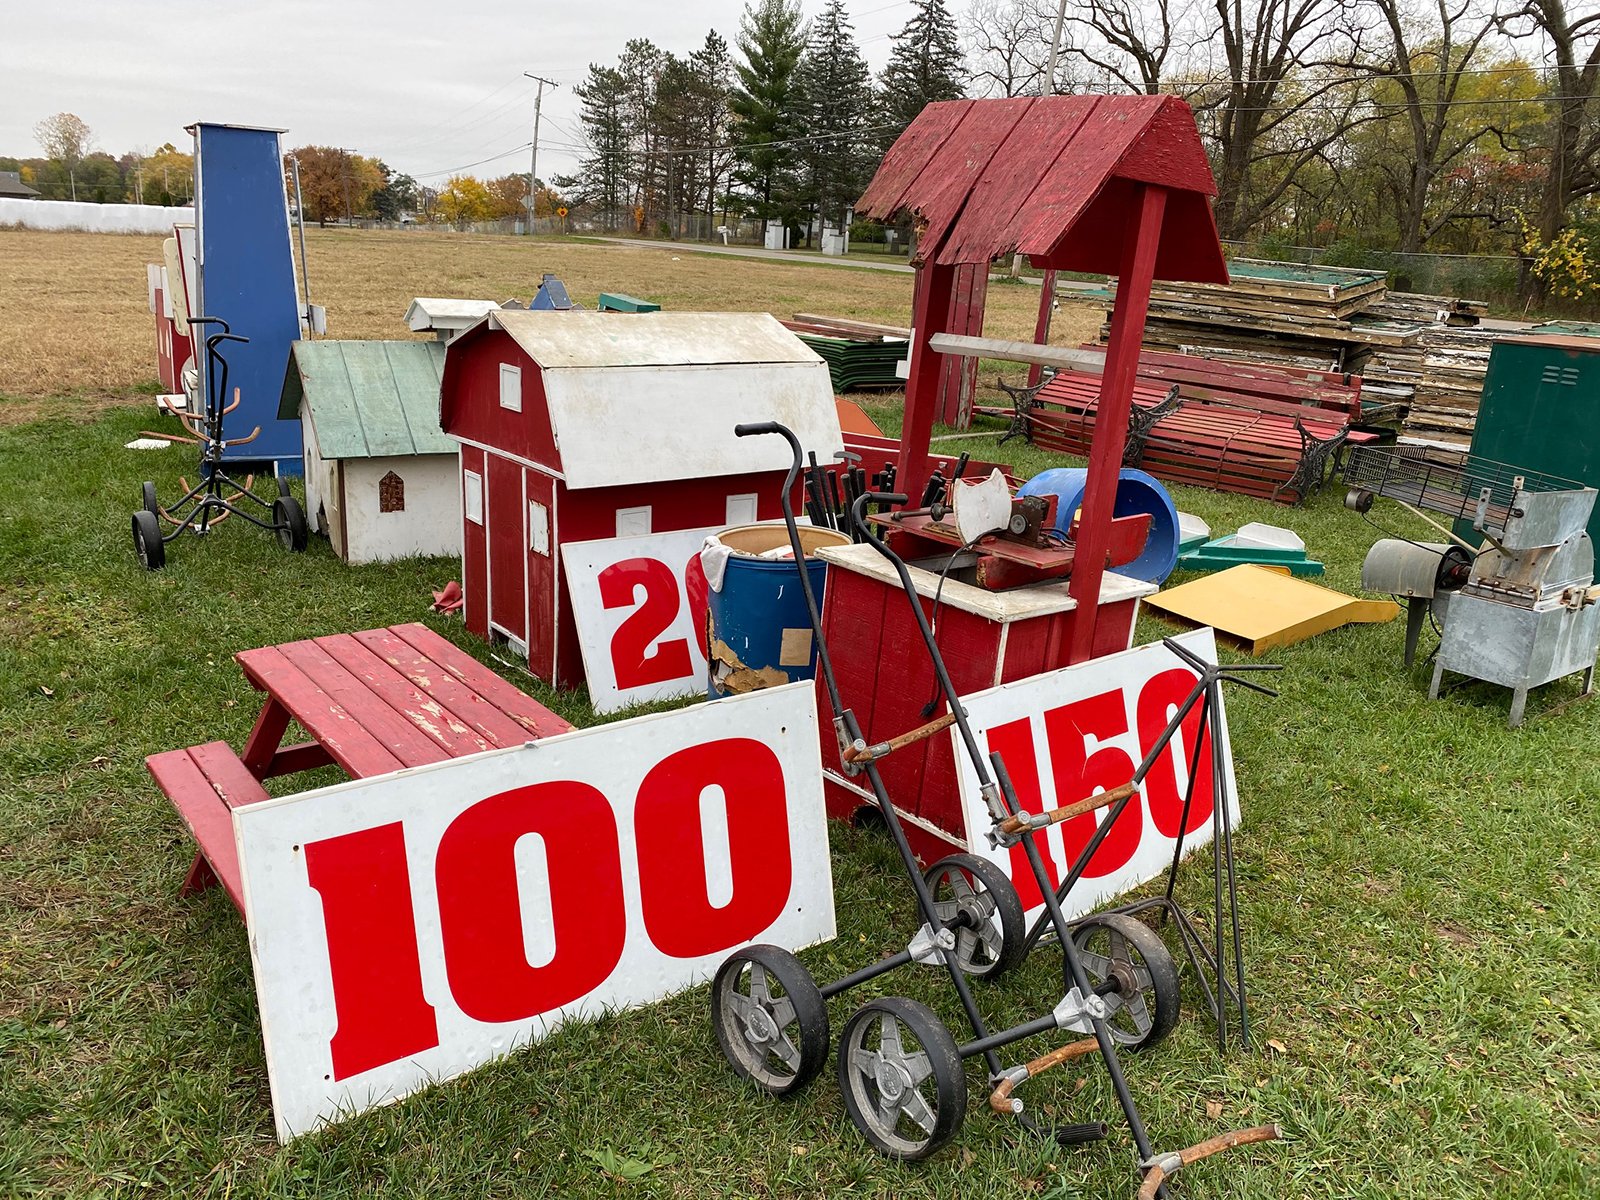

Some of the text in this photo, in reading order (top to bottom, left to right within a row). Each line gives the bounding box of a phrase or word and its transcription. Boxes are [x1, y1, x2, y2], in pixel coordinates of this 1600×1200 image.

[598, 552, 708, 690] 2
[305, 737, 792, 1081] 100
[986, 668, 1215, 912] 150
